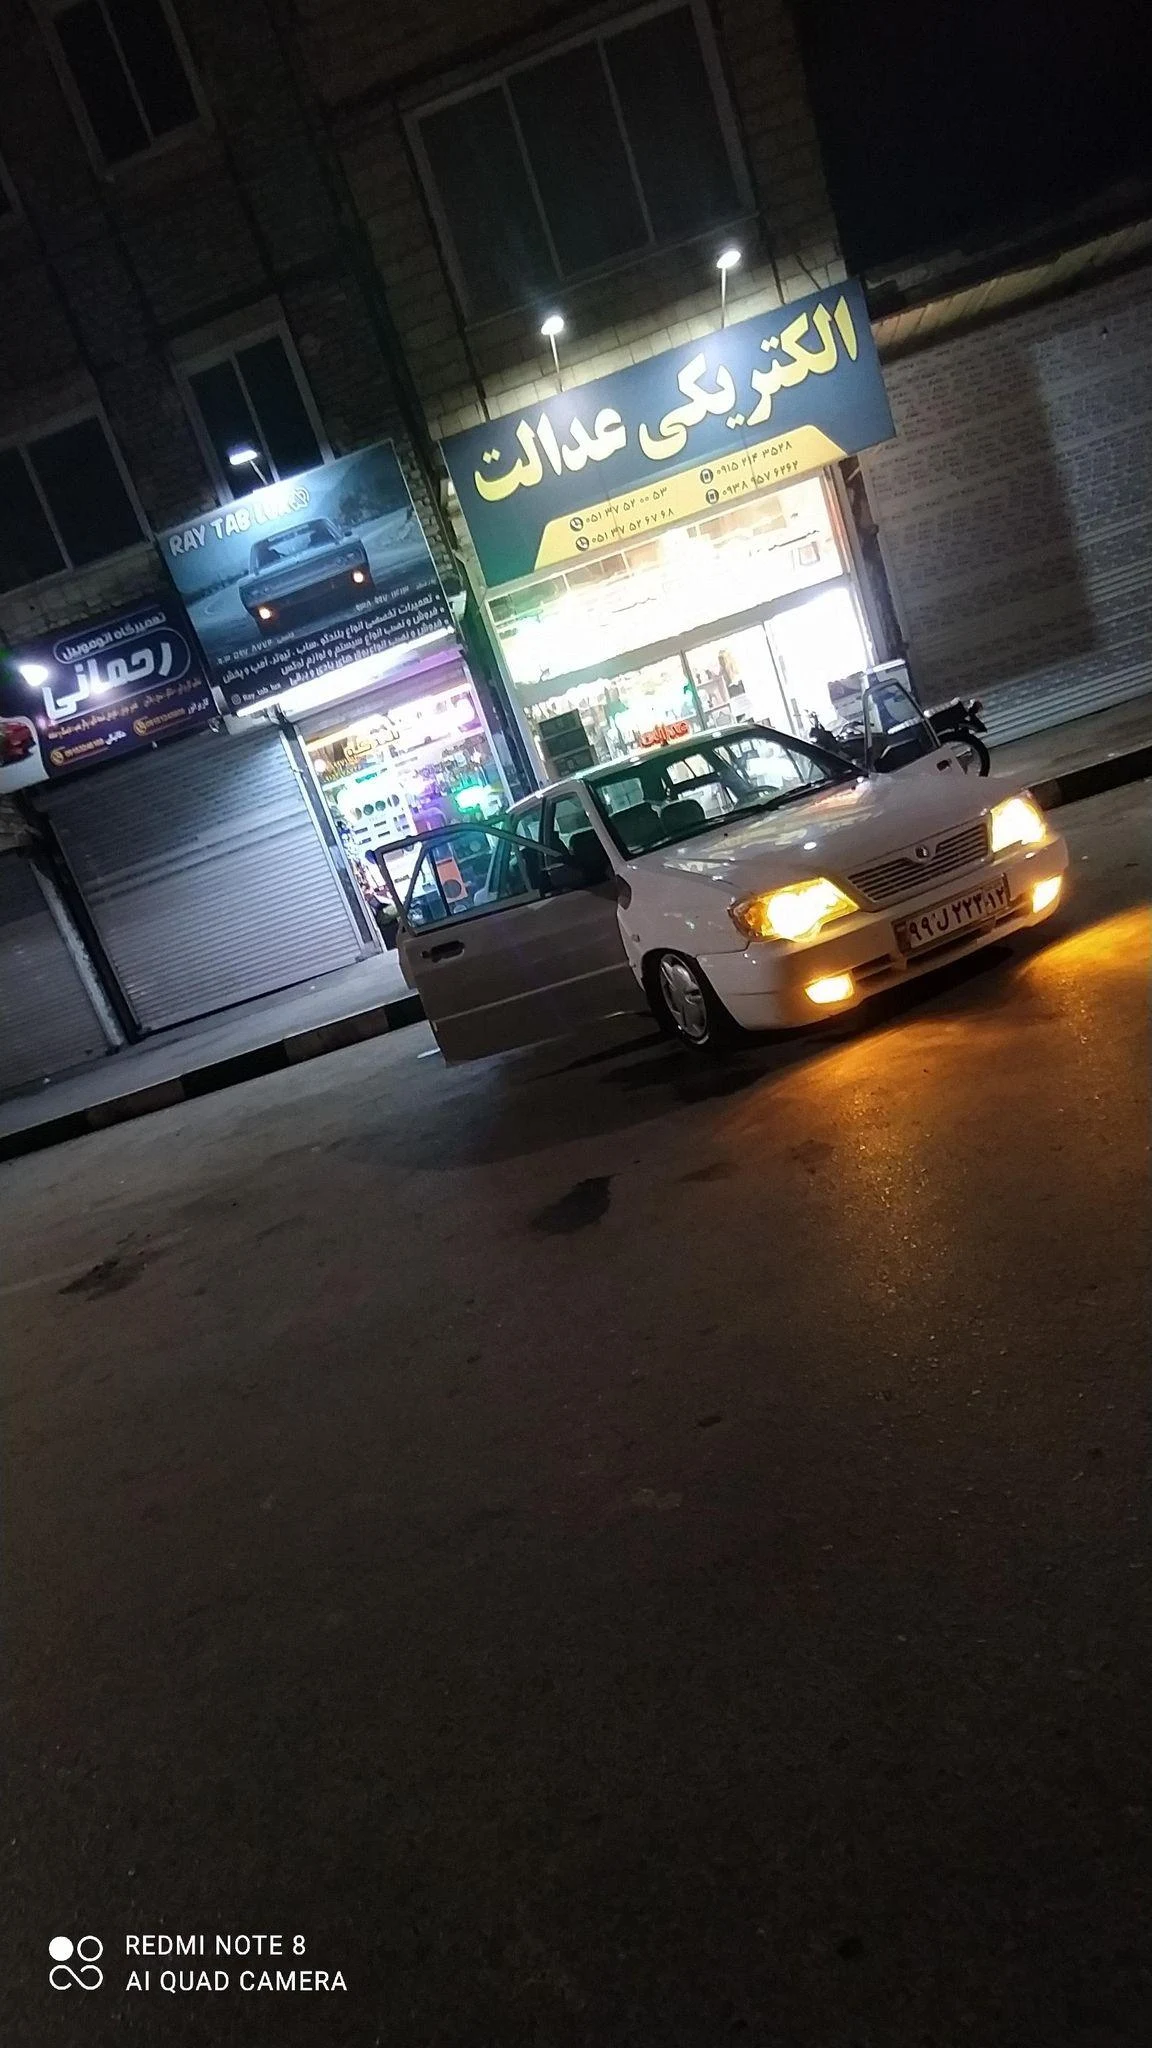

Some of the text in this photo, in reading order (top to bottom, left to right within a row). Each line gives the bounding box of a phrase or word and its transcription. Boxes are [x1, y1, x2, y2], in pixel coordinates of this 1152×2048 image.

[473, 295, 858, 502] الکتریکی عدالت
[169, 526, 206, 556] RAY
[212, 506, 252, 539] TAB
[113, 613, 166, 640] تعمیرگاه
[412, 606, 438, 625] فروش
[346, 621, 364, 638] انواع
[364, 628, 382, 645] انواع
[42, 642, 172, 720] رحمانی
[908, 917, 934, 941] ۹۹
